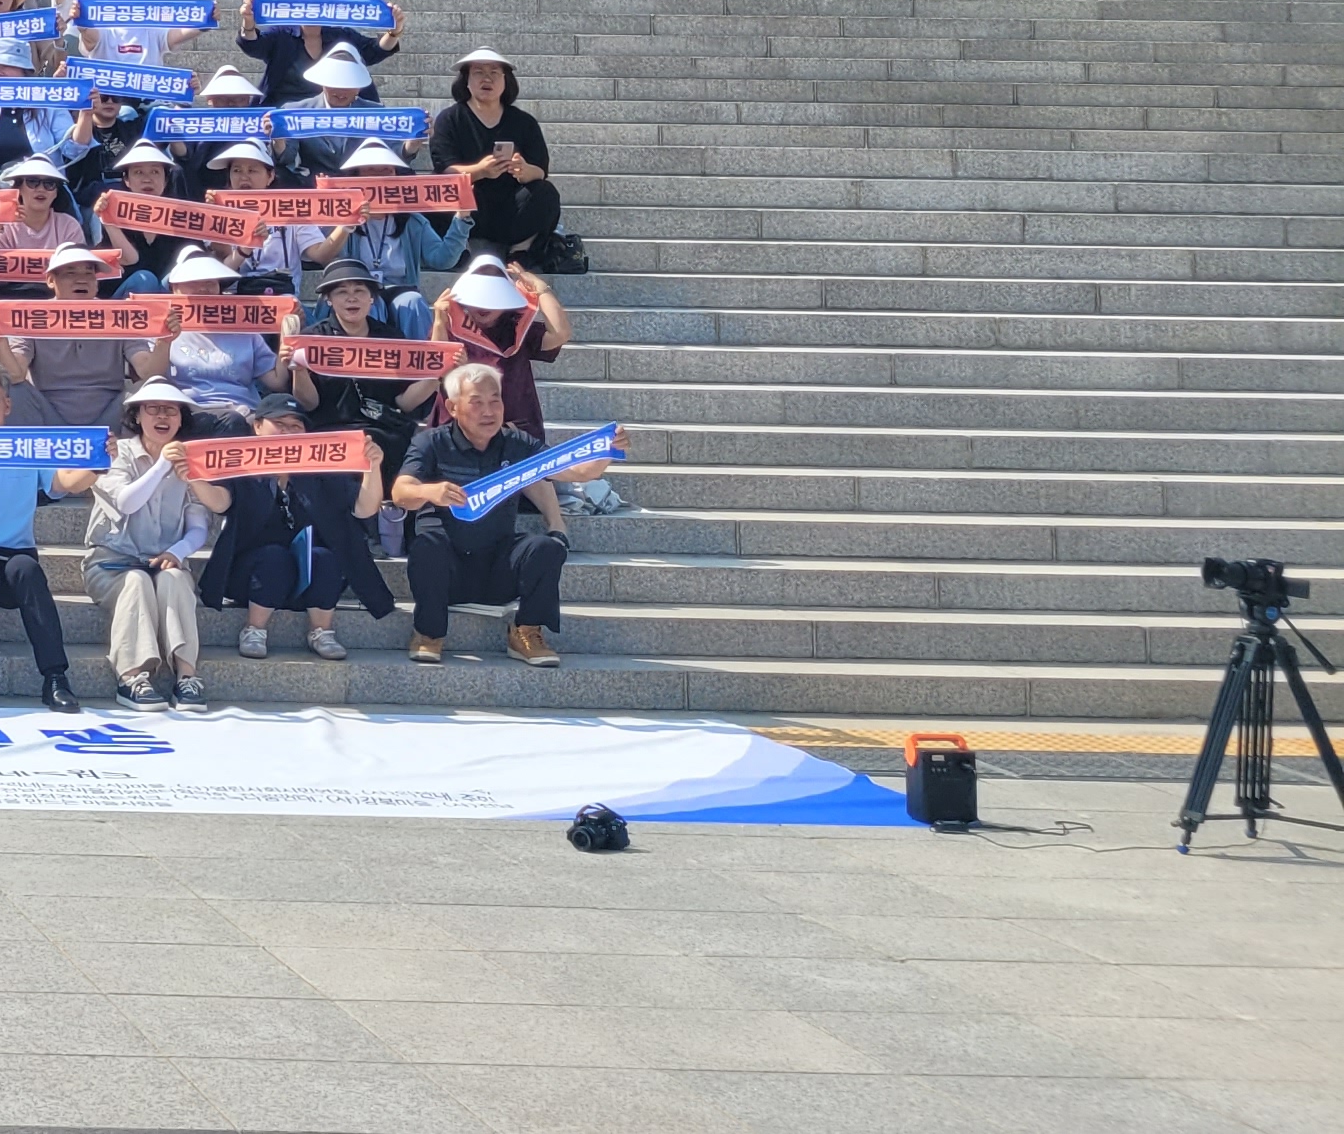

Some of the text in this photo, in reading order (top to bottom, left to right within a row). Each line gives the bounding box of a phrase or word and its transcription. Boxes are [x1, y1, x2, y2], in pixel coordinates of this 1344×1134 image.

[87, 4, 206, 23] 마을공동체활성화
[261, 3, 382, 21] 마을공동체활성화
[284, 114, 413, 134] 마을공동체활성화
[424, 184, 460, 203] 제정
[317, 198, 352, 216] 제정
[117, 201, 246, 237] 마을기본법 제정
[12, 308, 148, 330] 마을기본법 제정
[308, 346, 445, 370] 마을기본법 제정
[205, 442, 347, 468] 마을기본법 제정
